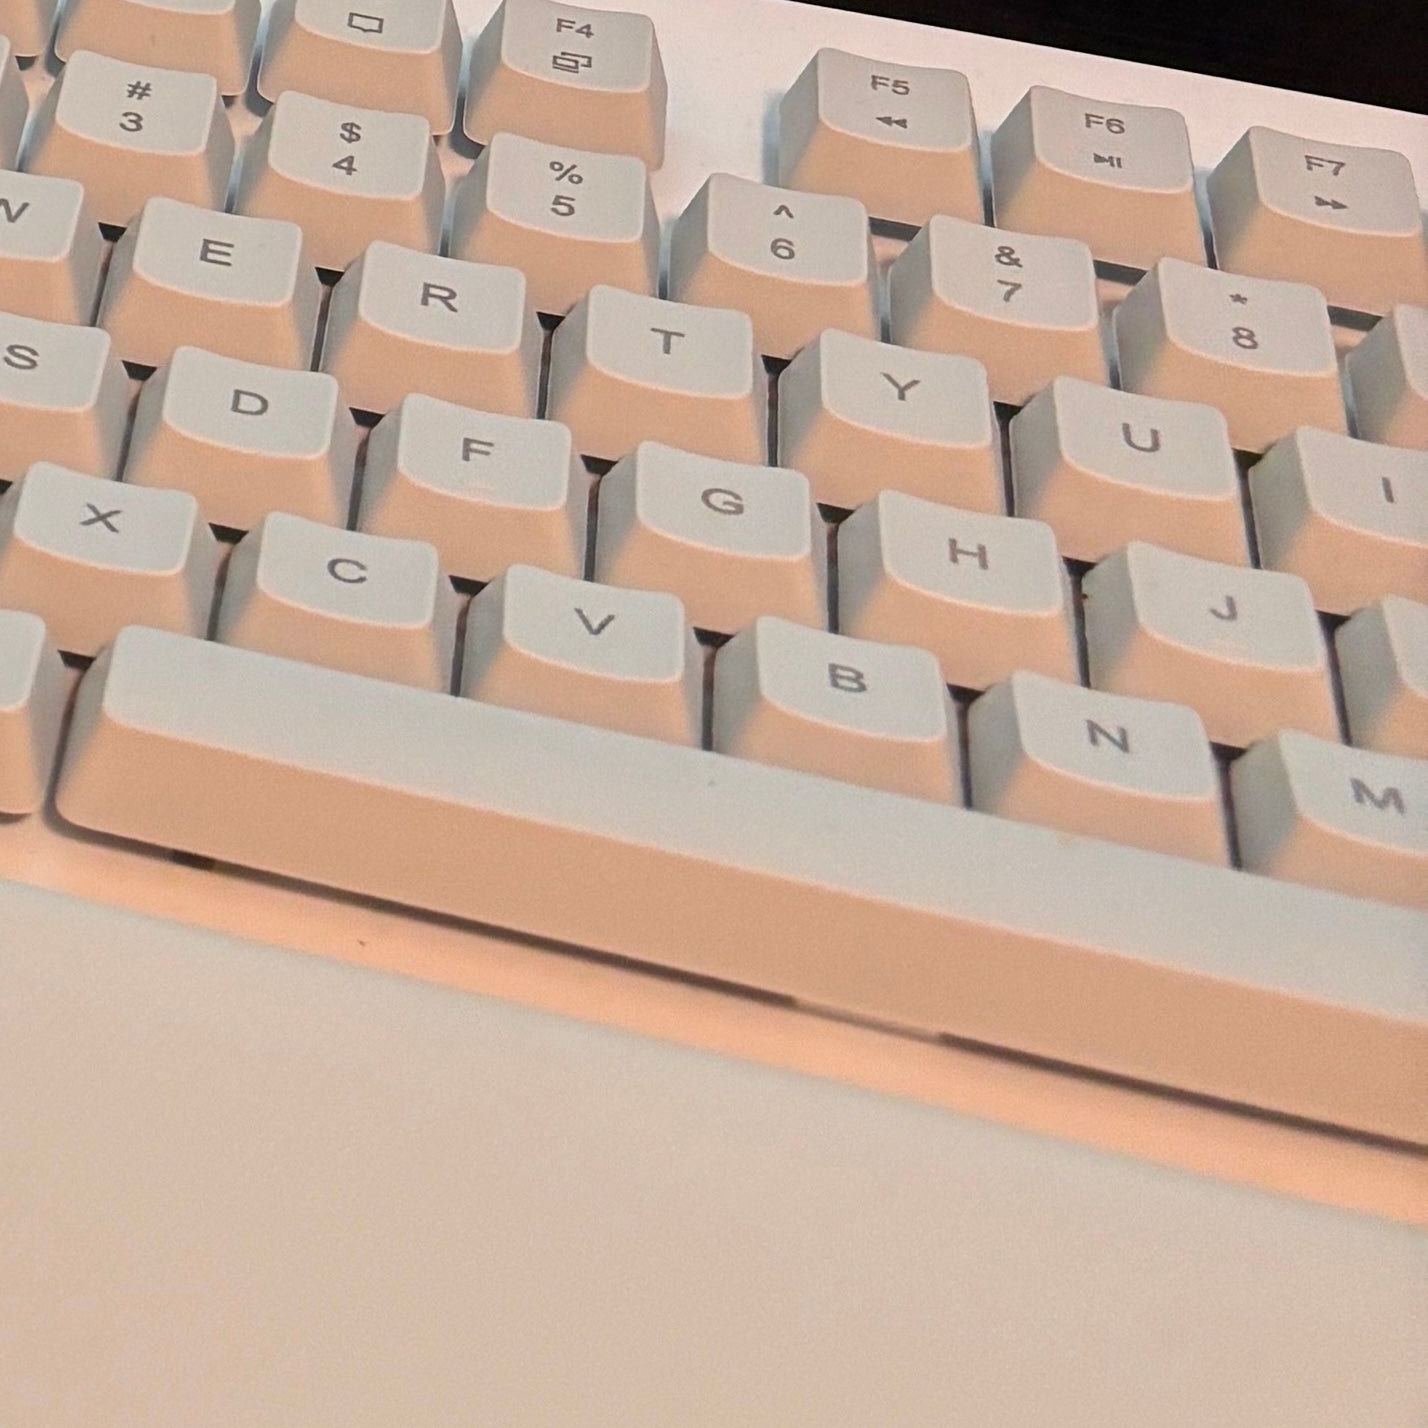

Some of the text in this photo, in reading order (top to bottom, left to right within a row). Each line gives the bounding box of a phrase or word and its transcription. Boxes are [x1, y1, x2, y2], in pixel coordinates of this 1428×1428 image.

[555, 17, 594, 39] F4
[870, 74, 911, 96] F5
[119, 111, 144, 133] 3
[1084, 112, 1126, 135] F6
[332, 155, 357, 176] 4
[1304, 154, 1346, 177] F7
[550, 194, 576, 217] 5
[199, 238, 235, 267] E
[770, 237, 796, 260] 6
[420, 282, 458, 313] R
[997, 279, 1023, 303] 7
[650, 327, 686, 355] T
[1232, 326, 1259, 350] 8
[3, 344, 39, 371] S
[882, 372, 921, 402] Y
[230, 388, 269, 416] D
[461, 437, 495, 462] F
[1121, 422, 1161, 454] U
[700, 487, 745, 516] G
[80, 503, 122, 534] X
[948, 537, 989, 571] H
[327, 557, 367, 584] C
[574, 607, 616, 636] V
[1209, 595, 1239, 622] J
[828, 663, 868, 694] B
[1086, 719, 1131, 754] N
[1350, 778, 1406, 815] M
